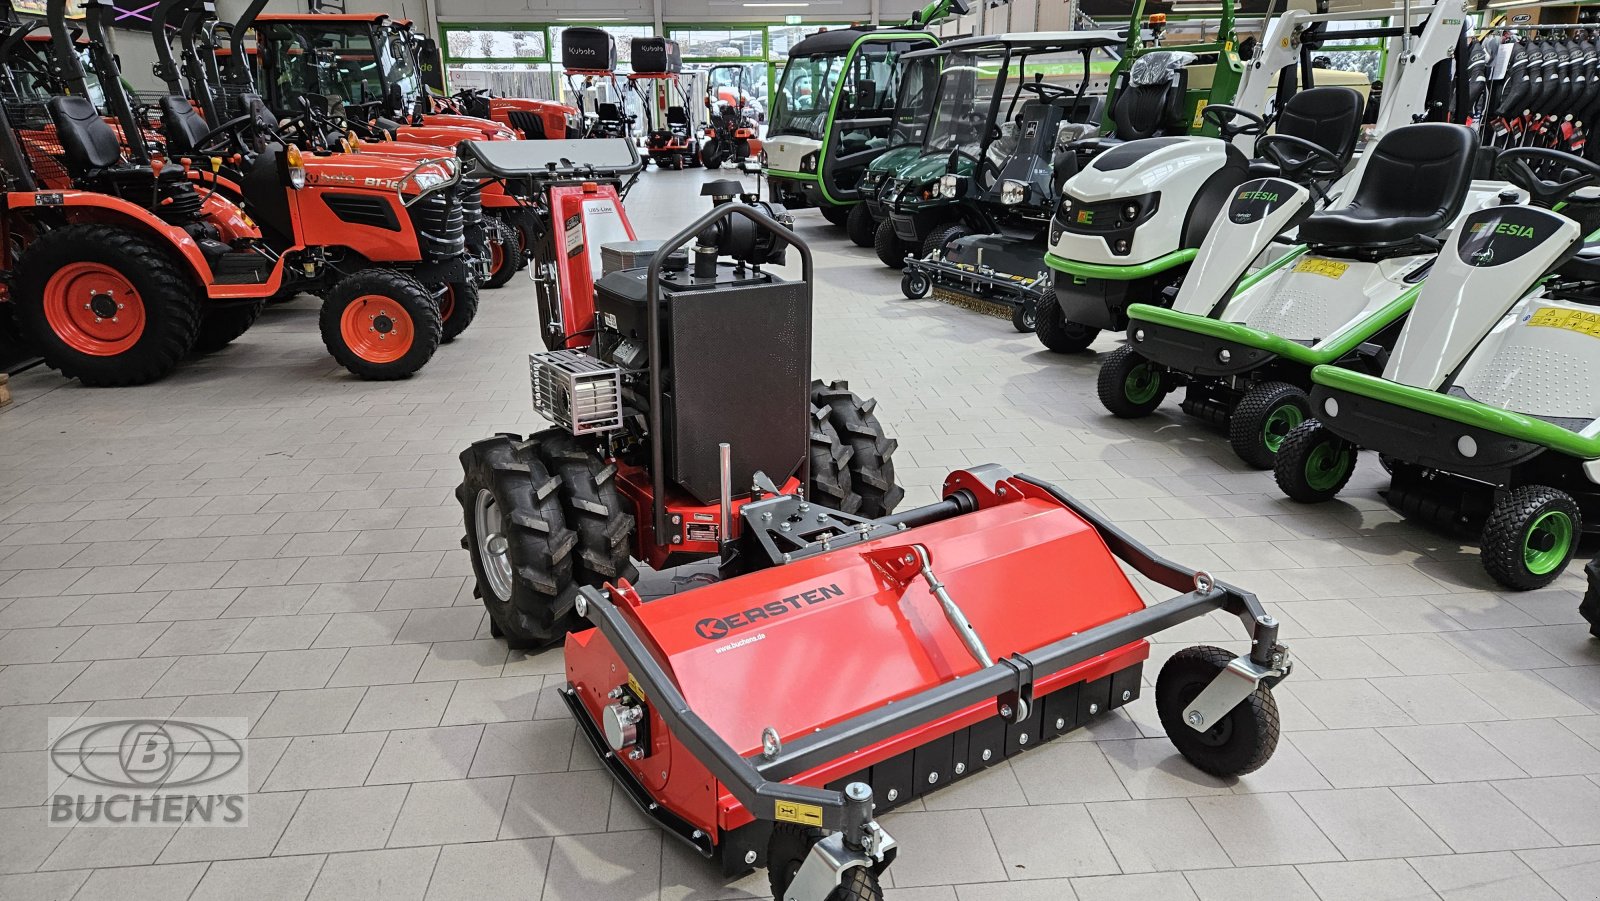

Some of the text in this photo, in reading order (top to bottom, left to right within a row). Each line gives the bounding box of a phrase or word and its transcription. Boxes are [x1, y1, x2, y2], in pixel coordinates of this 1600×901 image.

[568, 47, 596, 56] Kubota
[1241, 191, 1279, 202] ETESIA
[695, 583, 845, 640] KERSTEN
[714, 632, 767, 655] www.buchens.de
